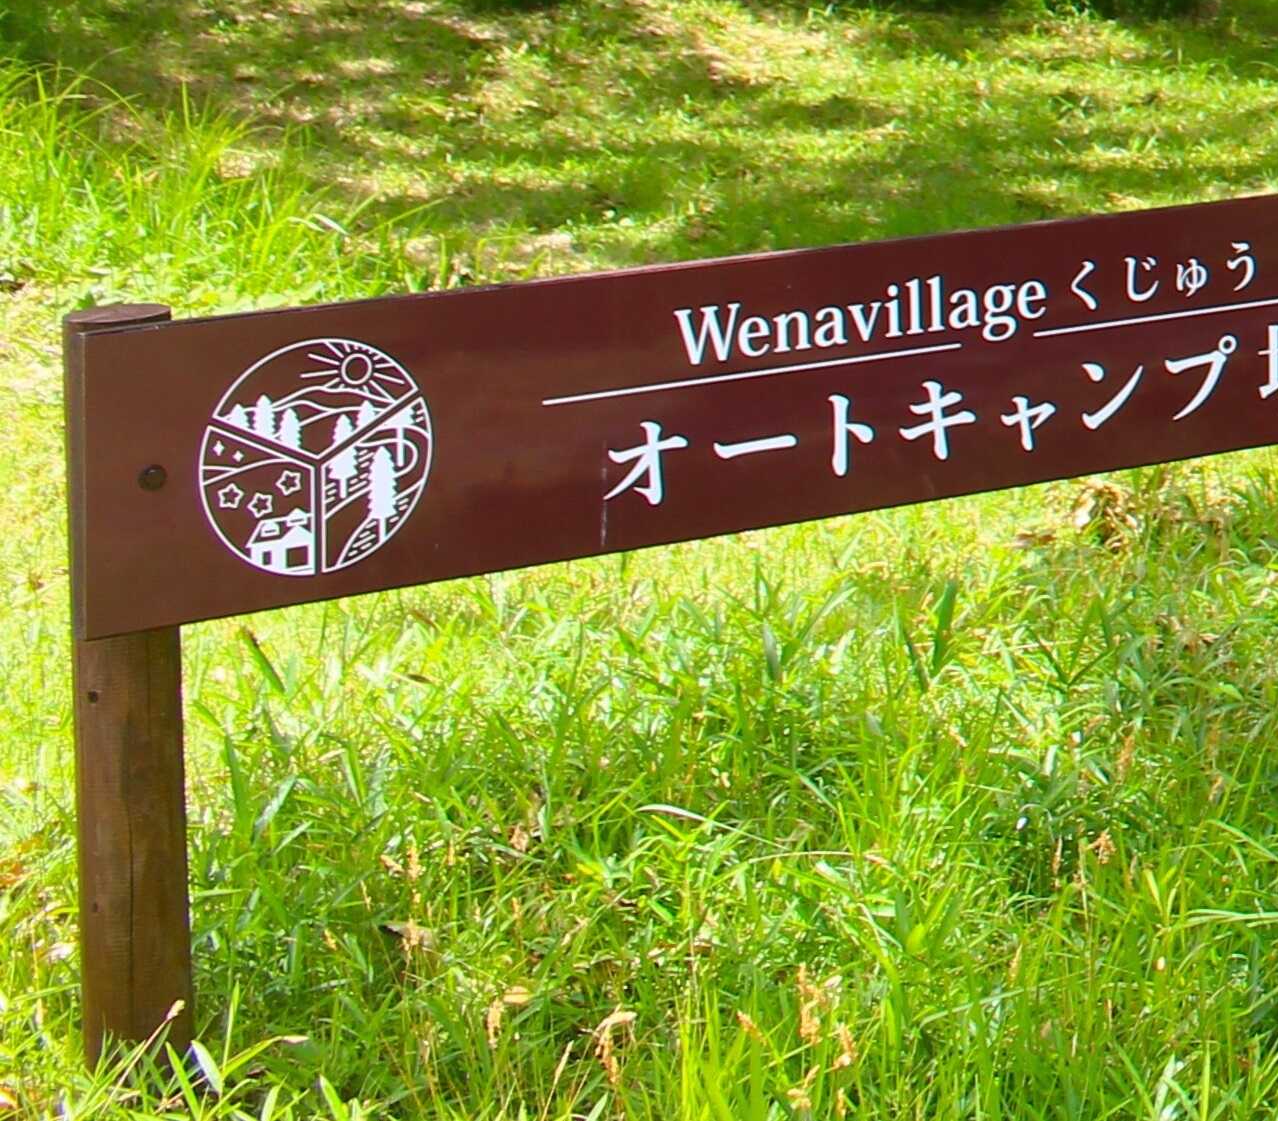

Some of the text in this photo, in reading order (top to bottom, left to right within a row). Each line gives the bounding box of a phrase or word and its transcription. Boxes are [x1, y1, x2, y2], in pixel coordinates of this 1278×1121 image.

[673, 241, 1256, 365] Wenavillage くじゅう
